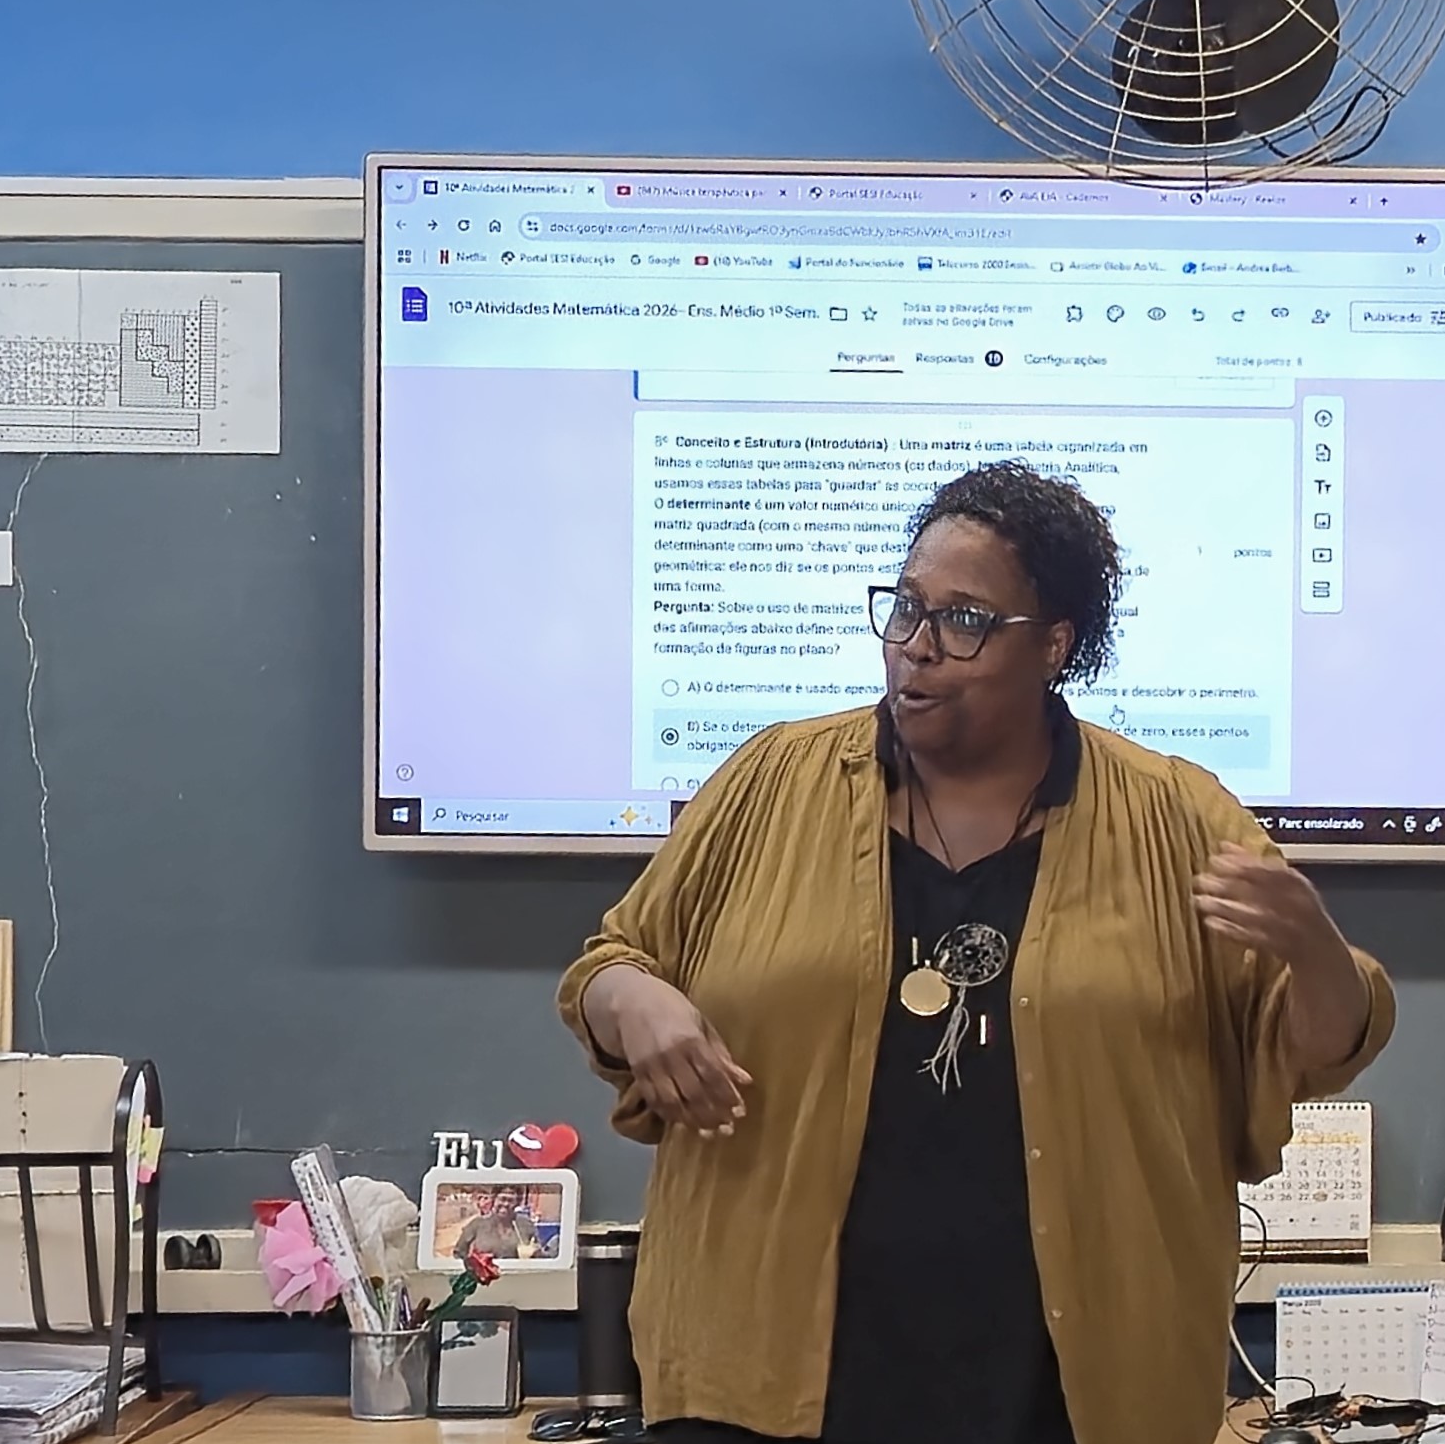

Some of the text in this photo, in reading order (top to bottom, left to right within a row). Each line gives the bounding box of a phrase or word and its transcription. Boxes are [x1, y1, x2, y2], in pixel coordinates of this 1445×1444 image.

[475, 302, 549, 315] Atividades
[553, 302, 640, 317] Matemática
[720, 304, 765, 318] Médio
[785, 307, 820, 319] Sem.
[676, 437, 730, 448] Conceito
[744, 437, 801, 449] Estrutura
[931, 441, 971, 452] matriz
[667, 497, 751, 510] determinante
[654, 601, 714, 615] Pergunta:
[456, 810, 510, 823] Pesquisar
